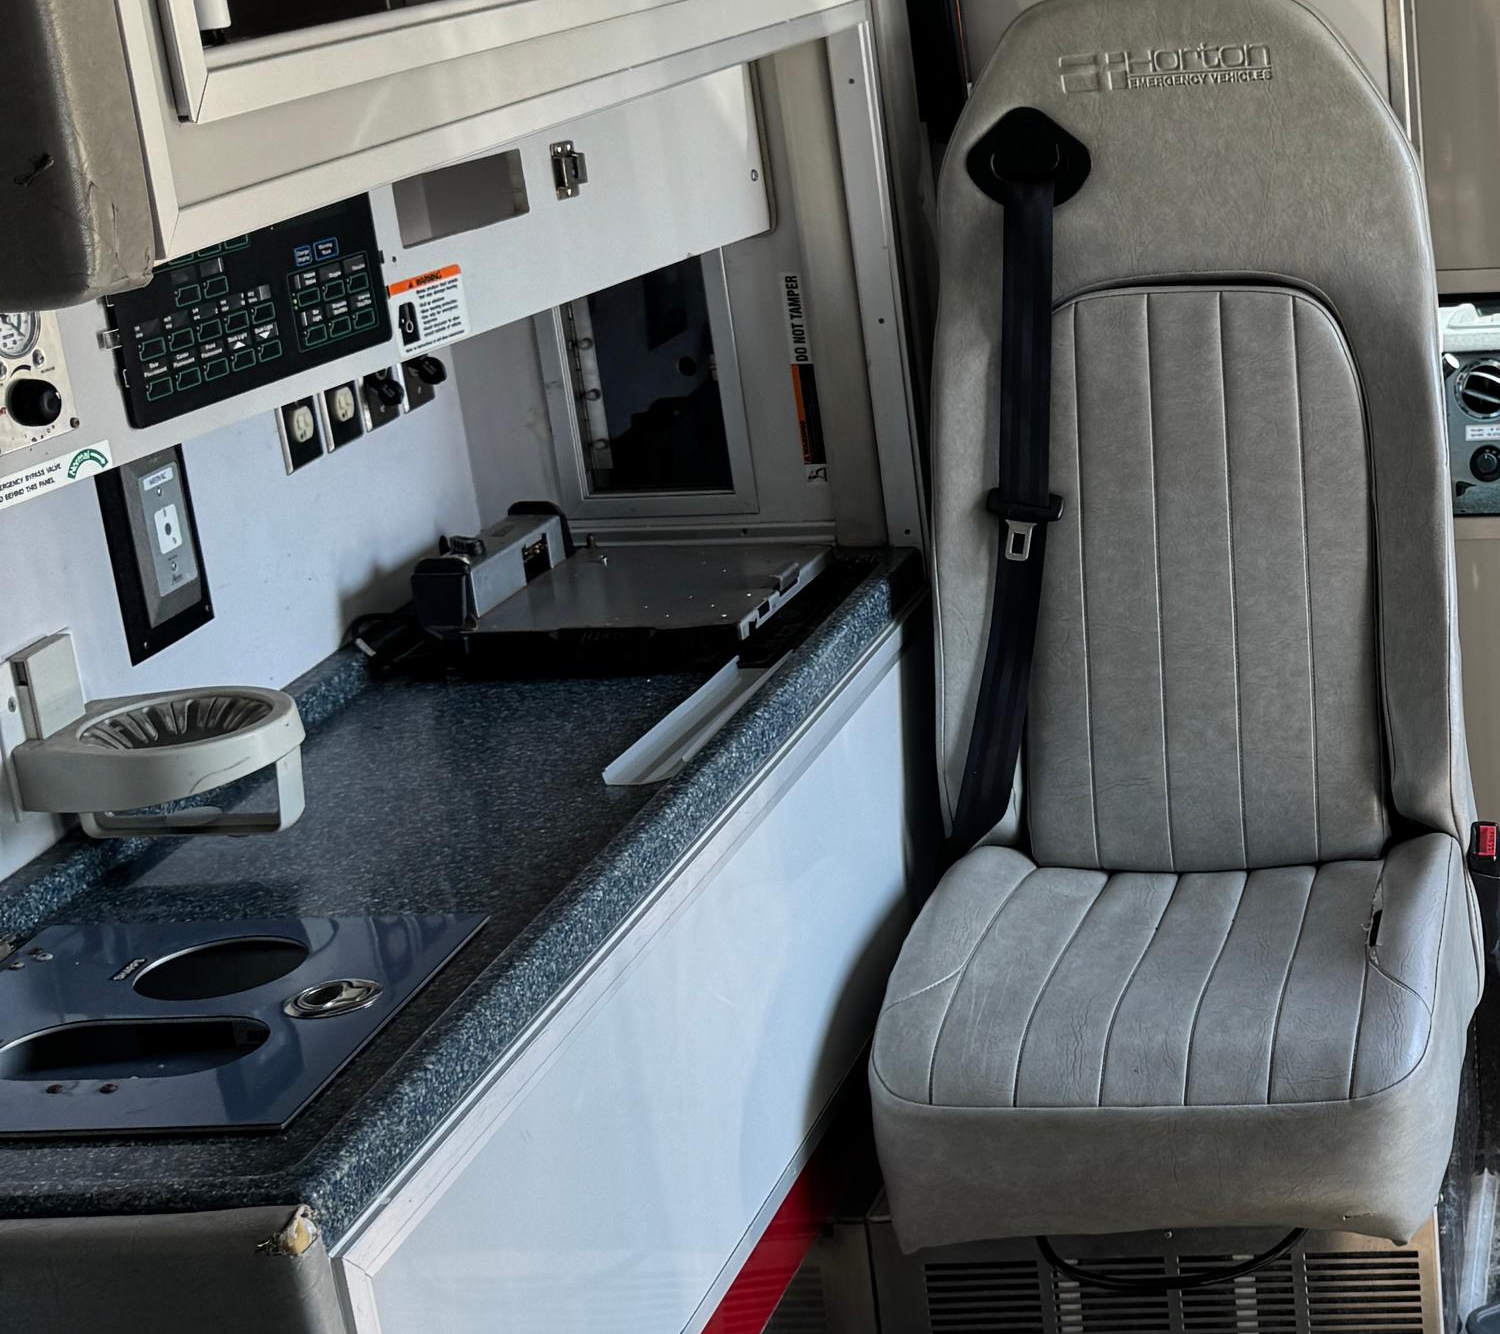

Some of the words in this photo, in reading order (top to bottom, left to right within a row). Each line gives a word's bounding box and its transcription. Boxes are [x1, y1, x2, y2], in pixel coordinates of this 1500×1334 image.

[1124, 42, 1272, 74] Horton
[1129, 73, 1208, 90] EMERGENCY
[1212, 69, 1273, 85] VEHICLES
[785, 275, 802, 321] TAMPER
[791, 321, 805, 345] NOT
[795, 346, 809, 363] DO
[25, 470, 46, 482] BYPASS
[39, 478, 55, 489] PANEL
